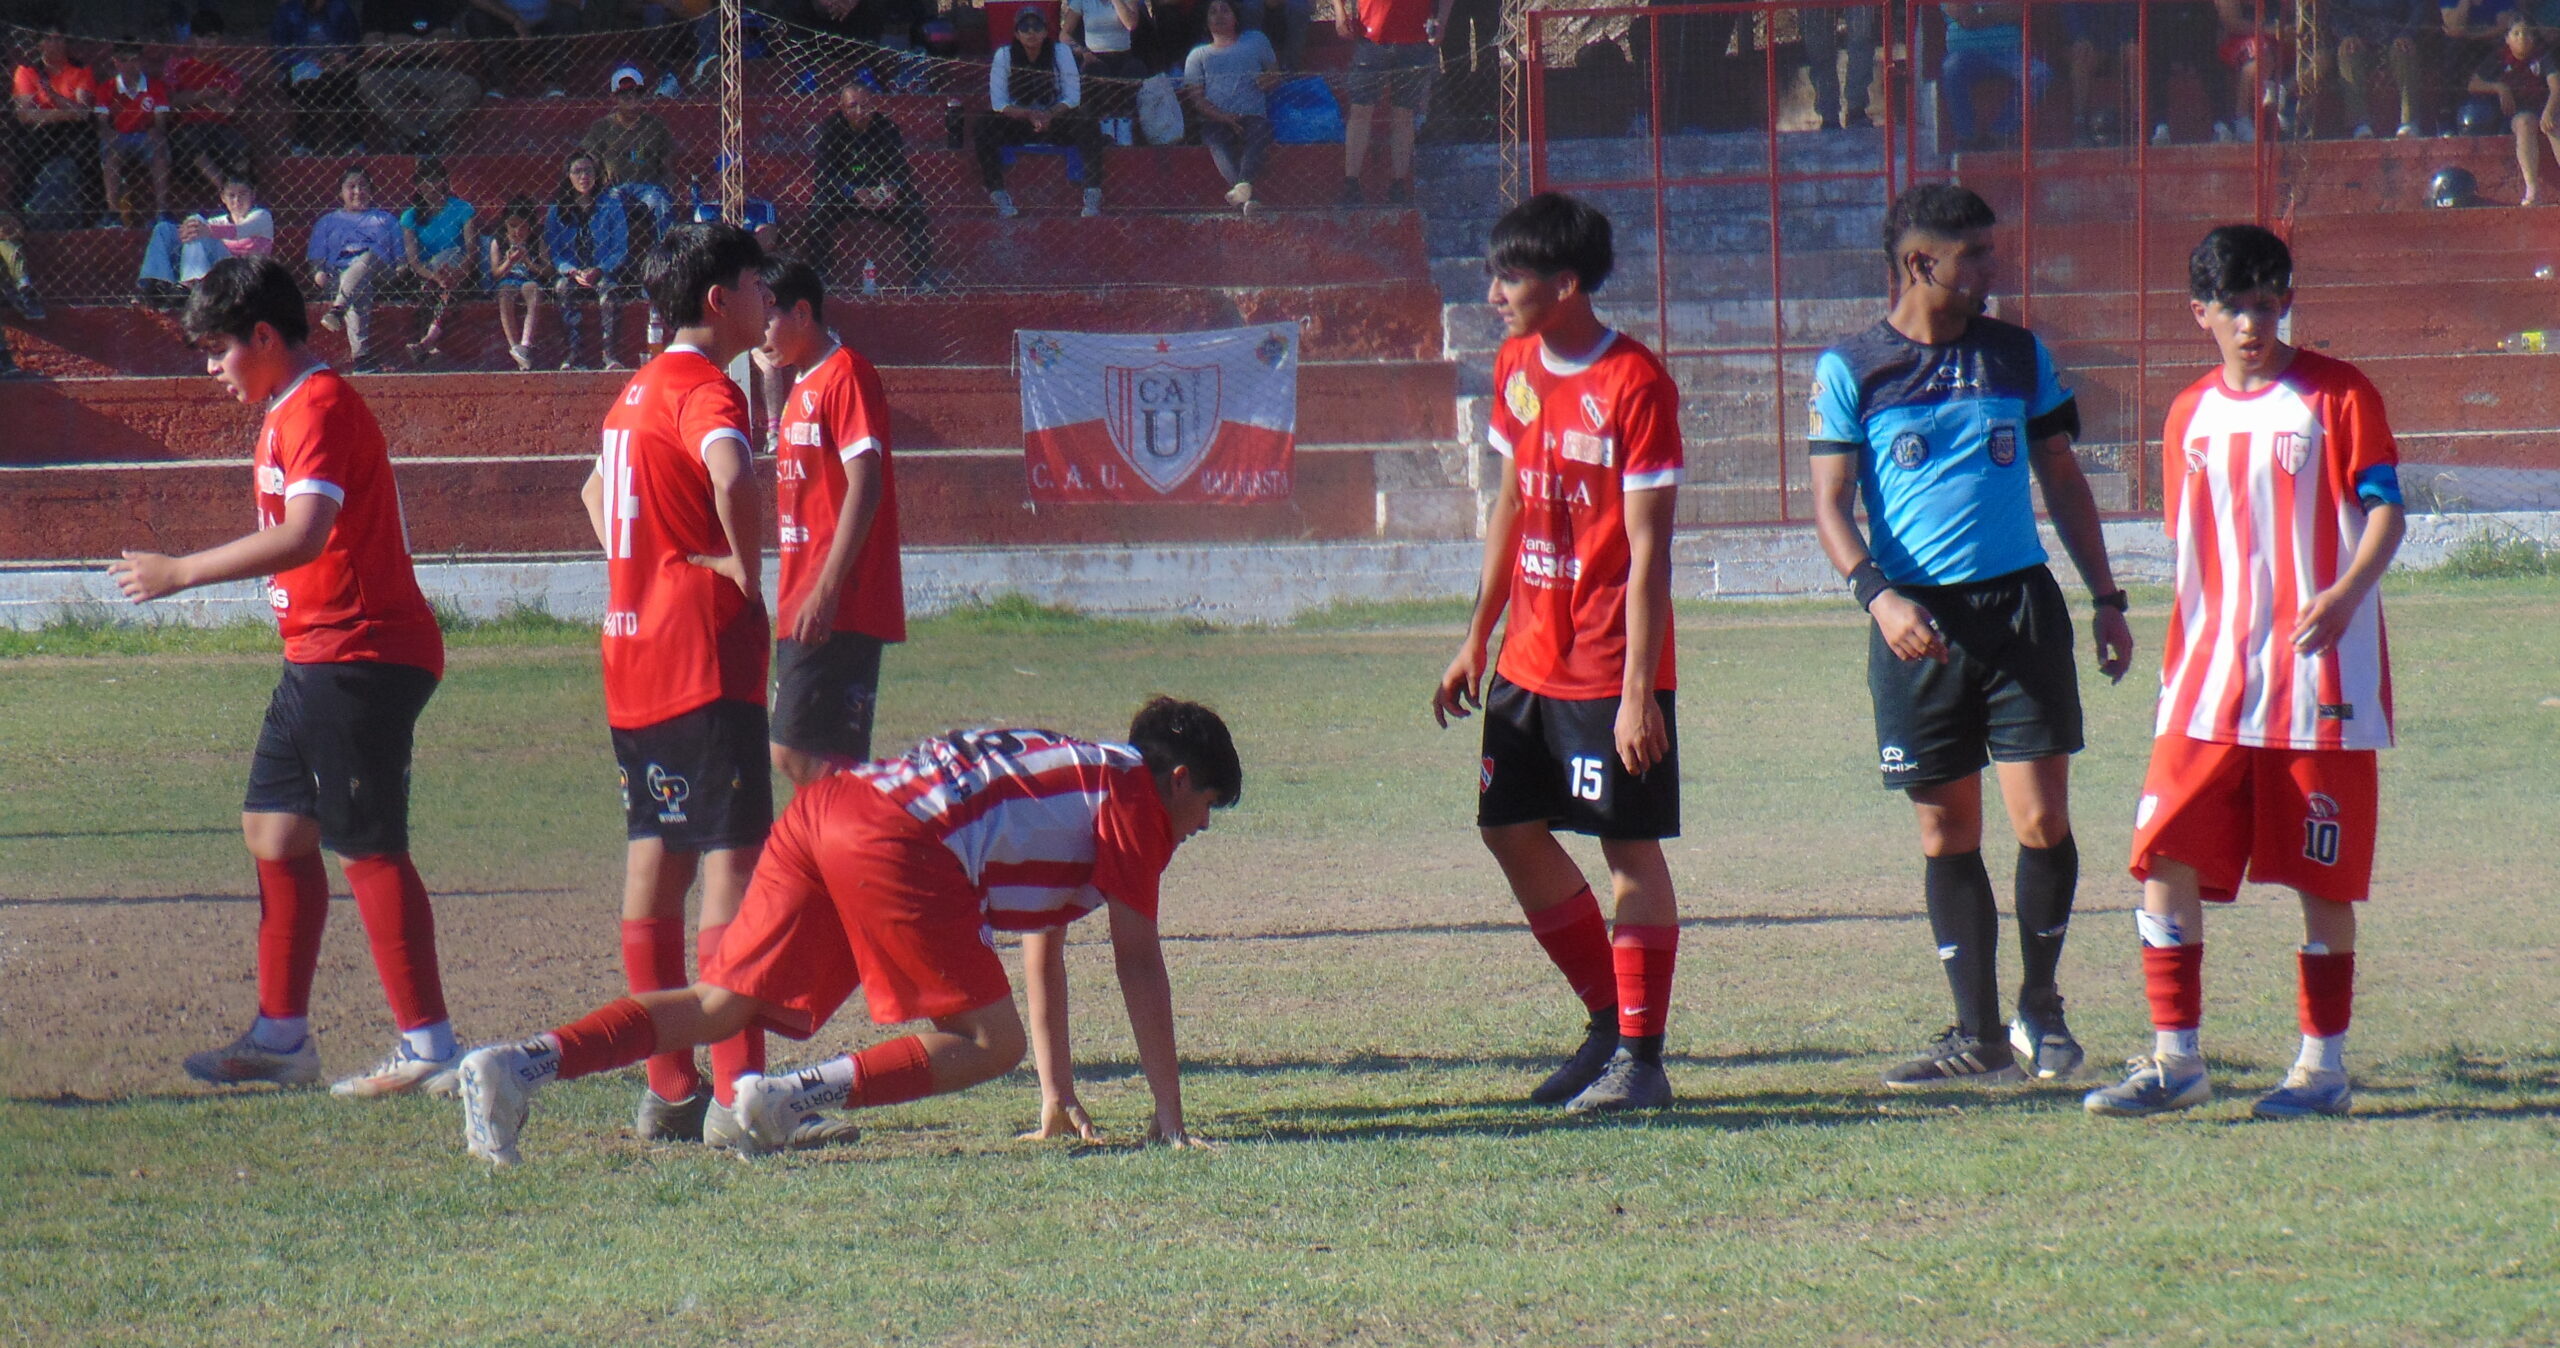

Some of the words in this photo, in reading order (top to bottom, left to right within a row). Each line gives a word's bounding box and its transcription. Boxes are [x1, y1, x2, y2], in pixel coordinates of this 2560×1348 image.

[603, 429, 639, 559] 14
[1571, 757, 1602, 800] 15
[2303, 818, 2341, 866] 10
